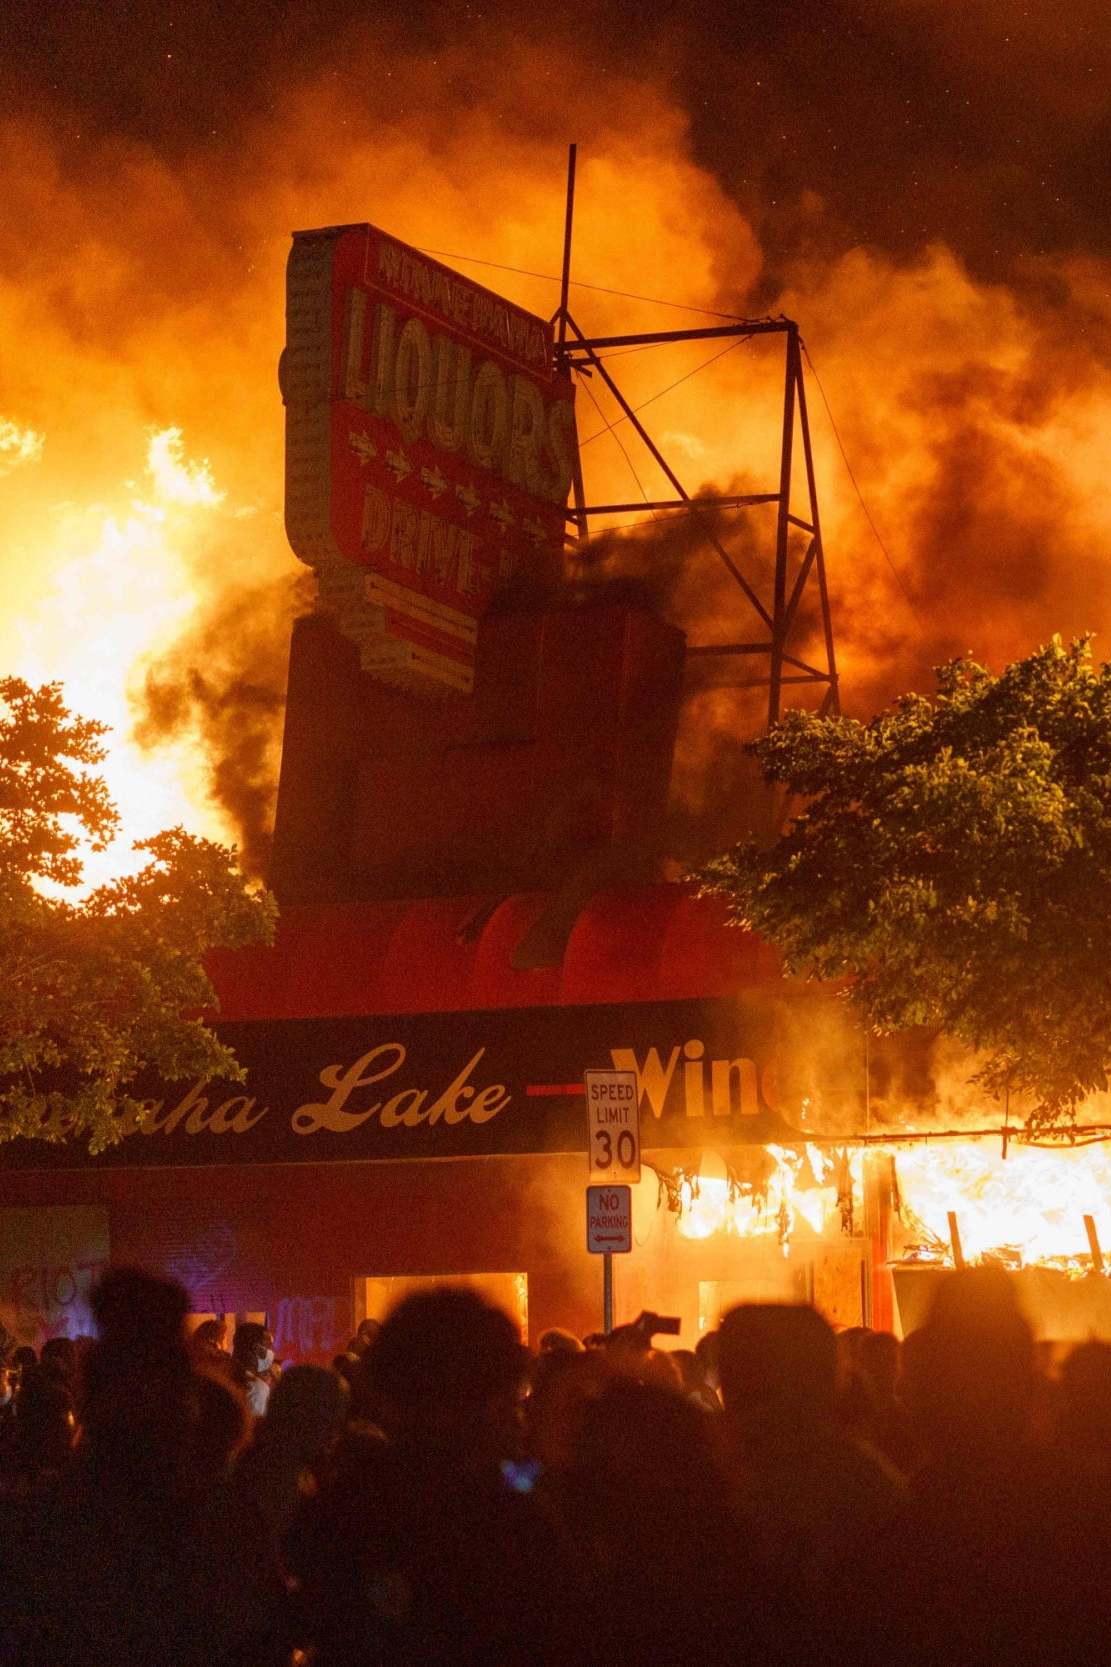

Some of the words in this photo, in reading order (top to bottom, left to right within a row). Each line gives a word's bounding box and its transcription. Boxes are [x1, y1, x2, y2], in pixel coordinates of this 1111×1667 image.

[343, 286, 575, 502] LIQUORS
[291, 1042, 511, 1136] Lake
[591, 1084, 634, 1101] SPEED
[596, 1106, 630, 1124] LIMIT
[594, 1130, 636, 1170] 30
[599, 1194, 619, 1211] NO
[590, 1215, 628, 1228] PARKING
